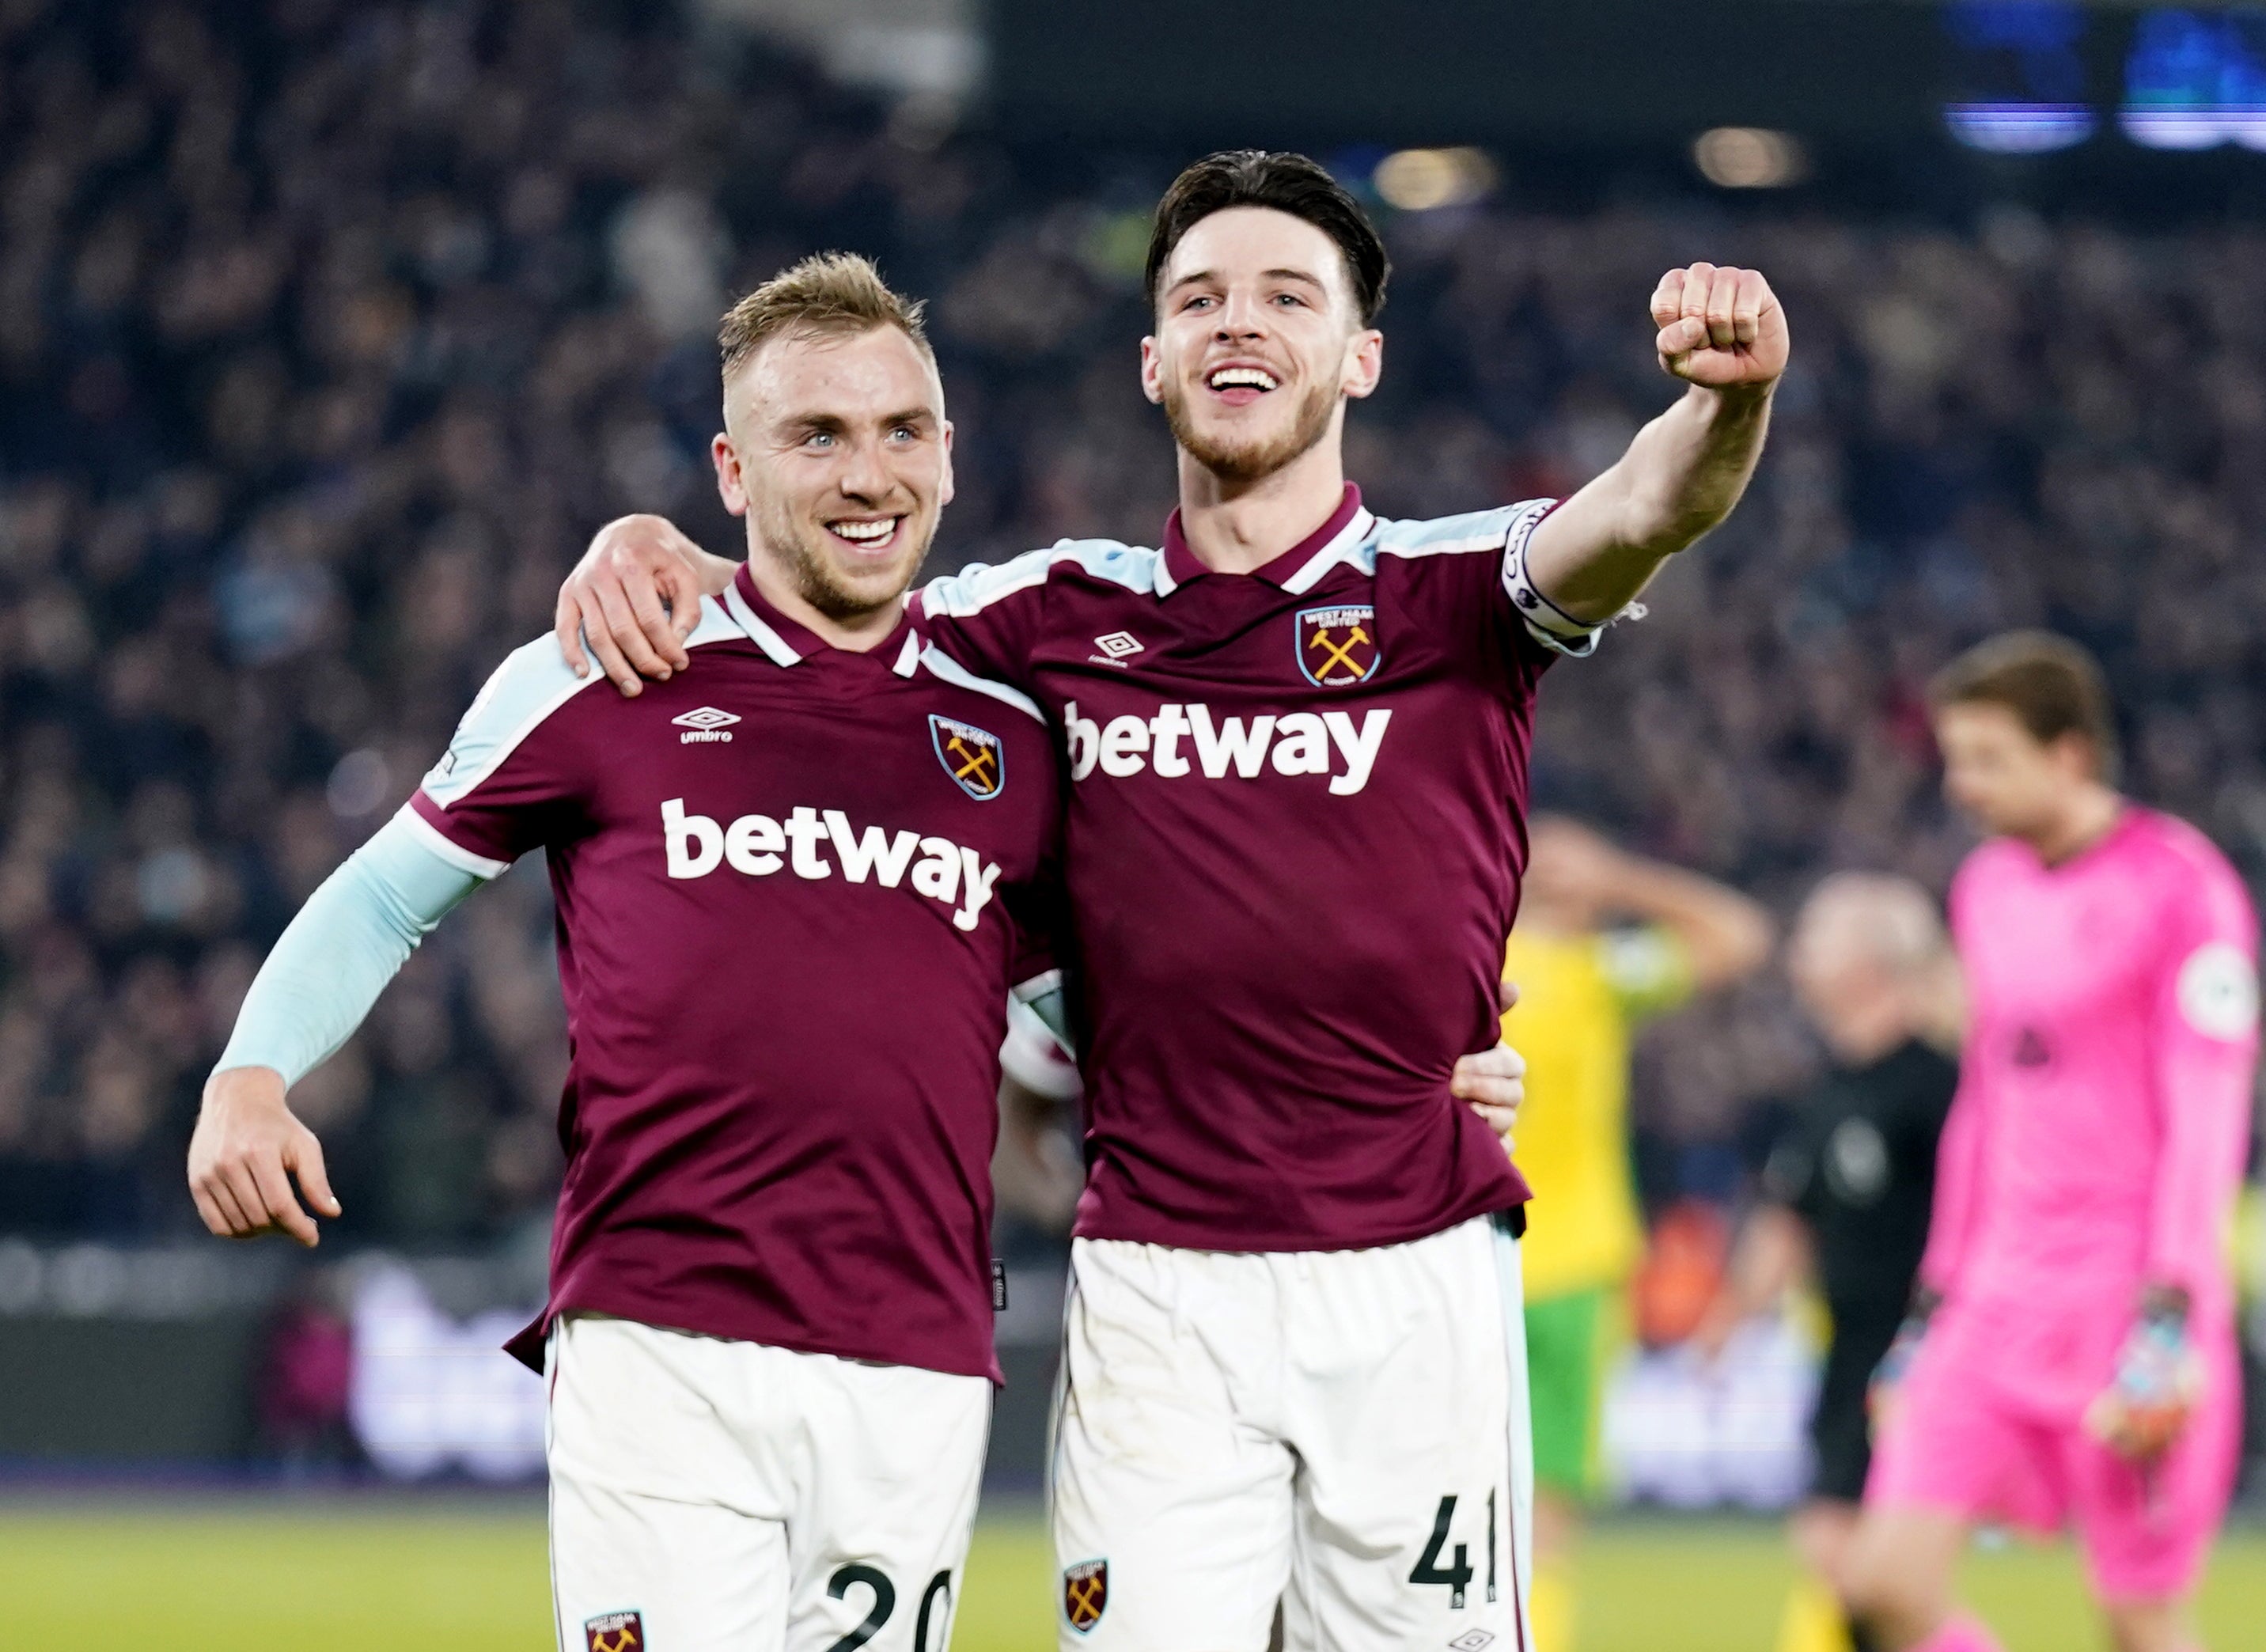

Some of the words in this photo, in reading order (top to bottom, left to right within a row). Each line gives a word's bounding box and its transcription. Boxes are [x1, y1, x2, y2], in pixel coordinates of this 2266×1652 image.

[680, 729, 733, 744] umbro
[1064, 700, 1393, 796] betway
[661, 798, 1002, 931] betway
[1408, 1487, 1497, 1609] 41
